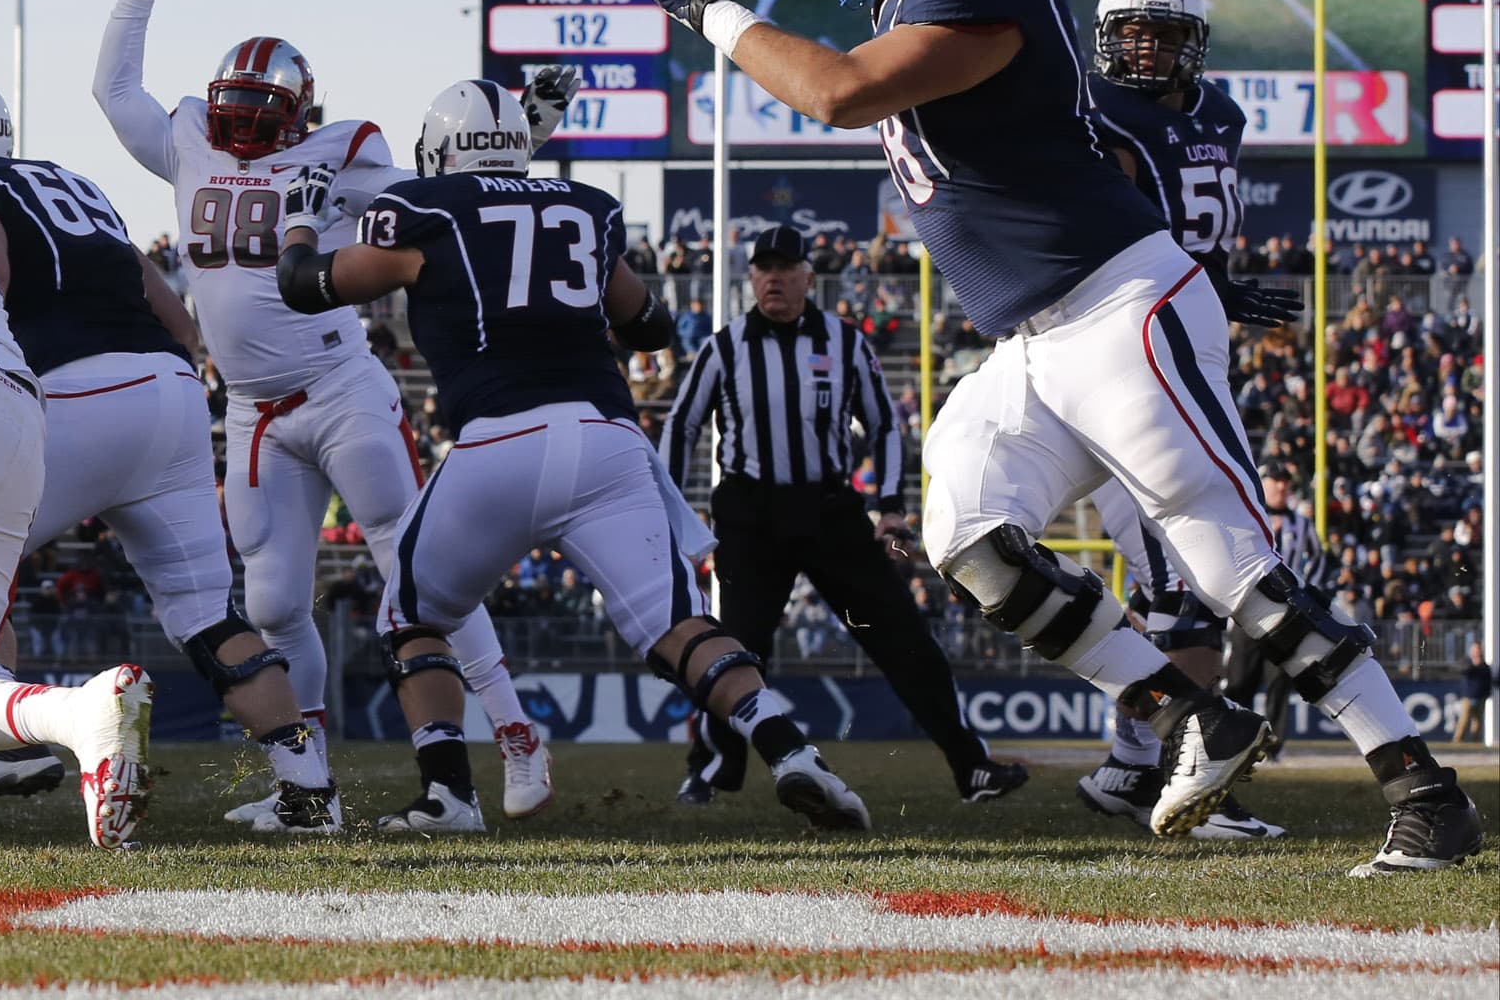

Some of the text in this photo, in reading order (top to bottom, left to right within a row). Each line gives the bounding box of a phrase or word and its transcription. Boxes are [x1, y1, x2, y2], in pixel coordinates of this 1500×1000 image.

[554, 14, 609, 46] 132
[592, 64, 636, 89] YDS
[1241, 78, 1279, 100] TOL
[1255, 107, 1268, 132] 3
[456, 131, 529, 152] UCONN
[1186, 145, 1229, 163] UCONN
[208, 176, 272, 187] RUTGERS
[11, 163, 132, 245] 69
[1179, 164, 1245, 254] 50
[187, 187, 281, 270] 98
[364, 209, 398, 248] 73
[1311, 219, 1430, 241] YUNDAI
[478, 203, 600, 309] 73
[1092, 767, 1142, 792] NIKE
